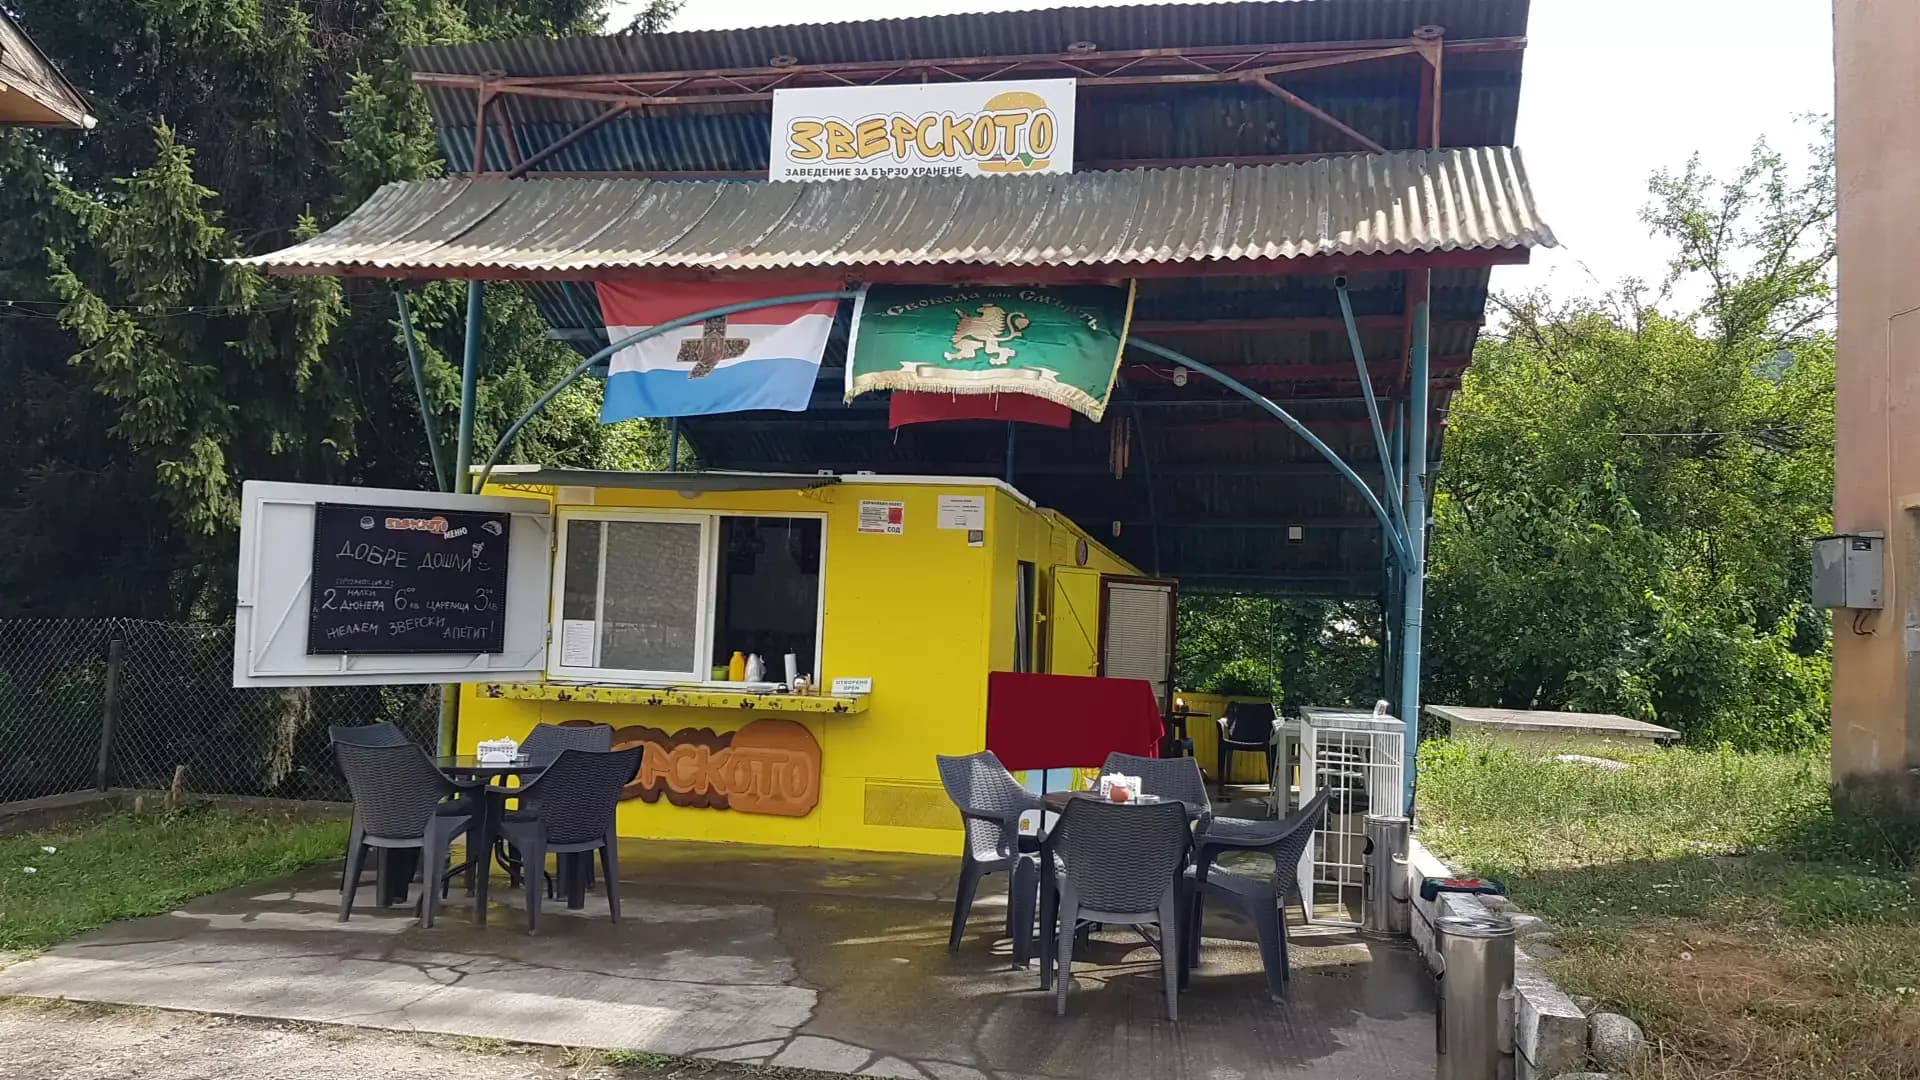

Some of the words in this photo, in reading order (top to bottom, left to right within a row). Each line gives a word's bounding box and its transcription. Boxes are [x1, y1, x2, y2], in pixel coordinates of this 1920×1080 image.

[791, 113, 1053, 159] ЗВЕРСКОТО
[785, 168, 851, 177] ЗАВЕДЕНИЕ
[854, 168, 868, 176] ЗА
[871, 167, 908, 176] БЪРЗО
[911, 166, 963, 176] ХРАНЕНЕ
[444, 527, 468, 540] МЕНЮ
[335, 540, 408, 567] ДОБРЕ
[417, 552, 472, 573] ДОШЛИ
[322, 588, 338, 610] 2
[340, 600, 384, 611] ДЮНЕРА
[327, 622, 378, 639] ЖЕЛАЕМ
[388, 616, 445, 635] ЗВЕРСКИ
